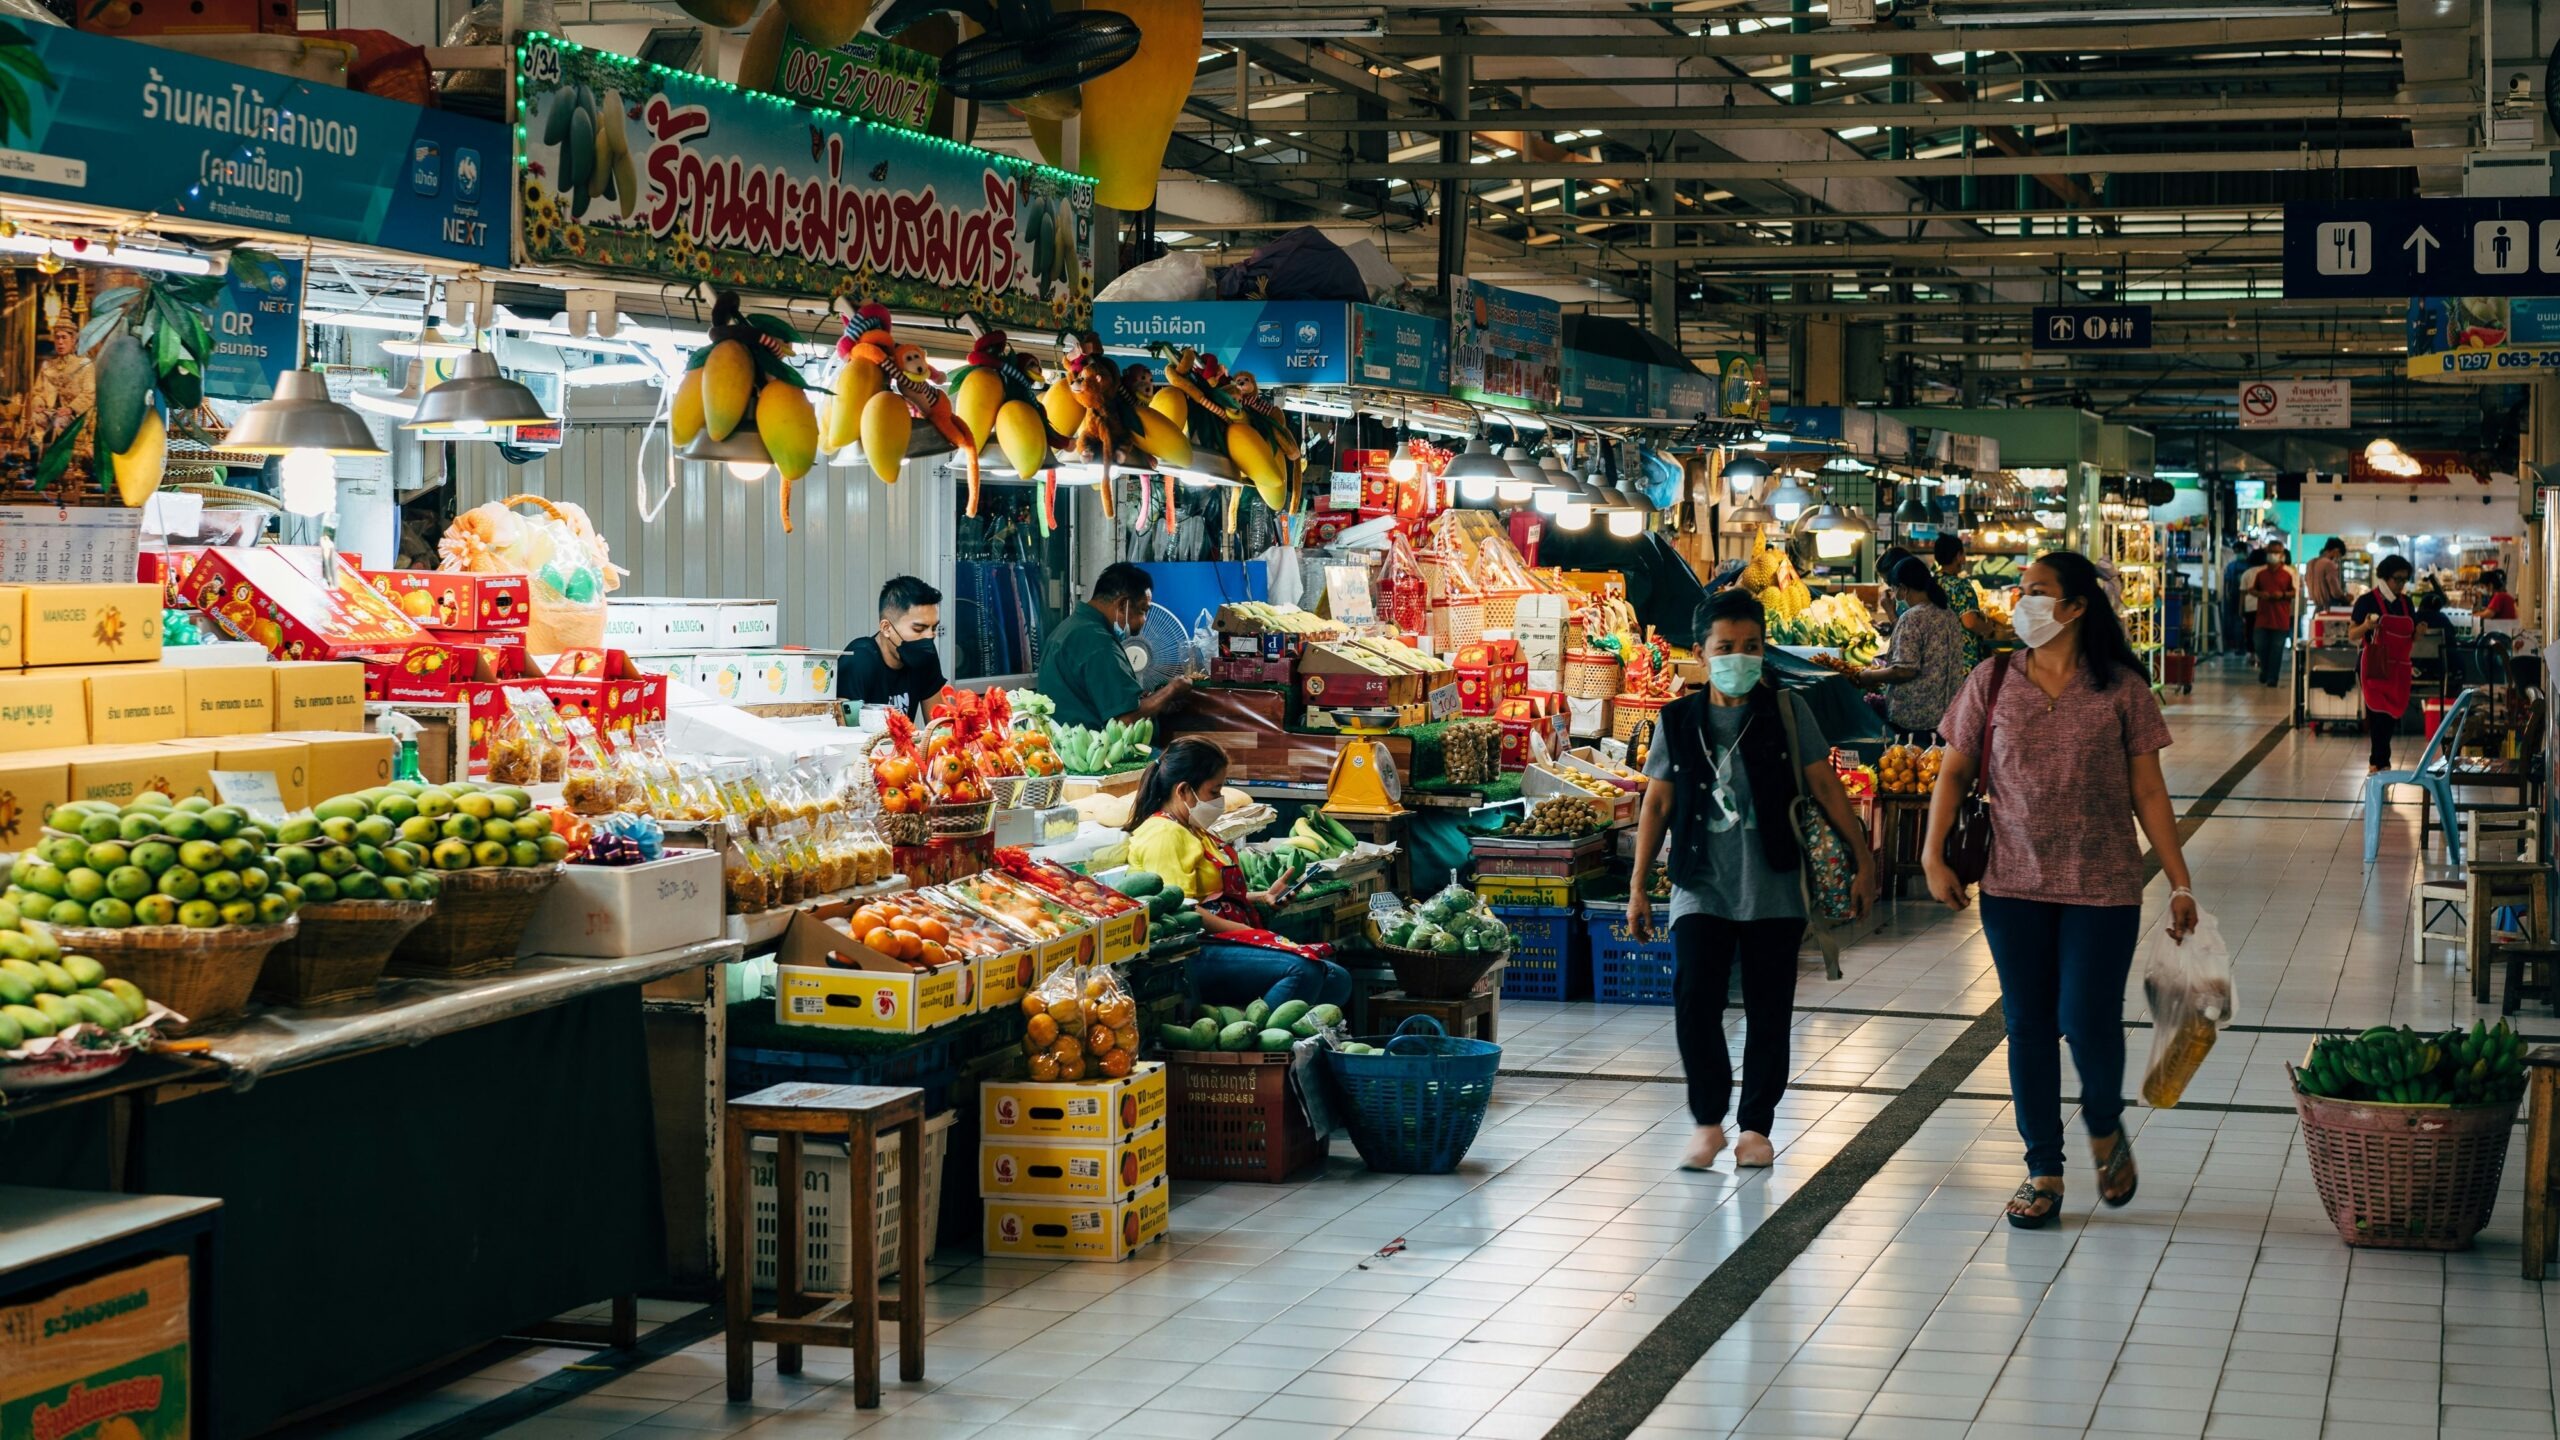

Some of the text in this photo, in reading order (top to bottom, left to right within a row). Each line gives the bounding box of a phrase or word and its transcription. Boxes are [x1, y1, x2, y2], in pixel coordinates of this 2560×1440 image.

[784, 47, 930, 126] 081-2790074
[142, 66, 360, 157] ร้านผลไม้กลางดง
[646, 95, 1016, 296] ร้านมะม่วงสมศรี
[1072, 183, 1092, 209] 6/35
[443, 217, 488, 247] NEXT
[259, 301, 294, 315] NEXT
[221, 311, 254, 336] QR
[1113, 315, 1206, 335] ร้านเจ๊เผือก
[1286, 355, 1329, 368] NEXT
[2459, 353, 2491, 371] 1297
[21, 540, 27, 549] 3
[65, 541, 71, 550] 5
[87, 542, 93, 550] 6
[109, 541, 115, 550] 7
[15, 552, 26, 561] 10
[37, 553, 48, 562] 11
[59, 553, 71, 562] 12
[81, 554, 93, 562] 13
[103, 554, 114, 563] 14
[15, 564, 26, 573] 17
[37, 565, 48, 574] 18
[59, 565, 70, 574] 19
[80, 566, 92, 575] 20
[102, 566, 113, 575] 21
[43, 609, 87, 622] MANGOES
[672, 620, 702, 633] MANGO
[738, 620, 764, 633] MANGO
[1439, 693, 1457, 713] 100
[86, 782, 134, 800] MANGOES
